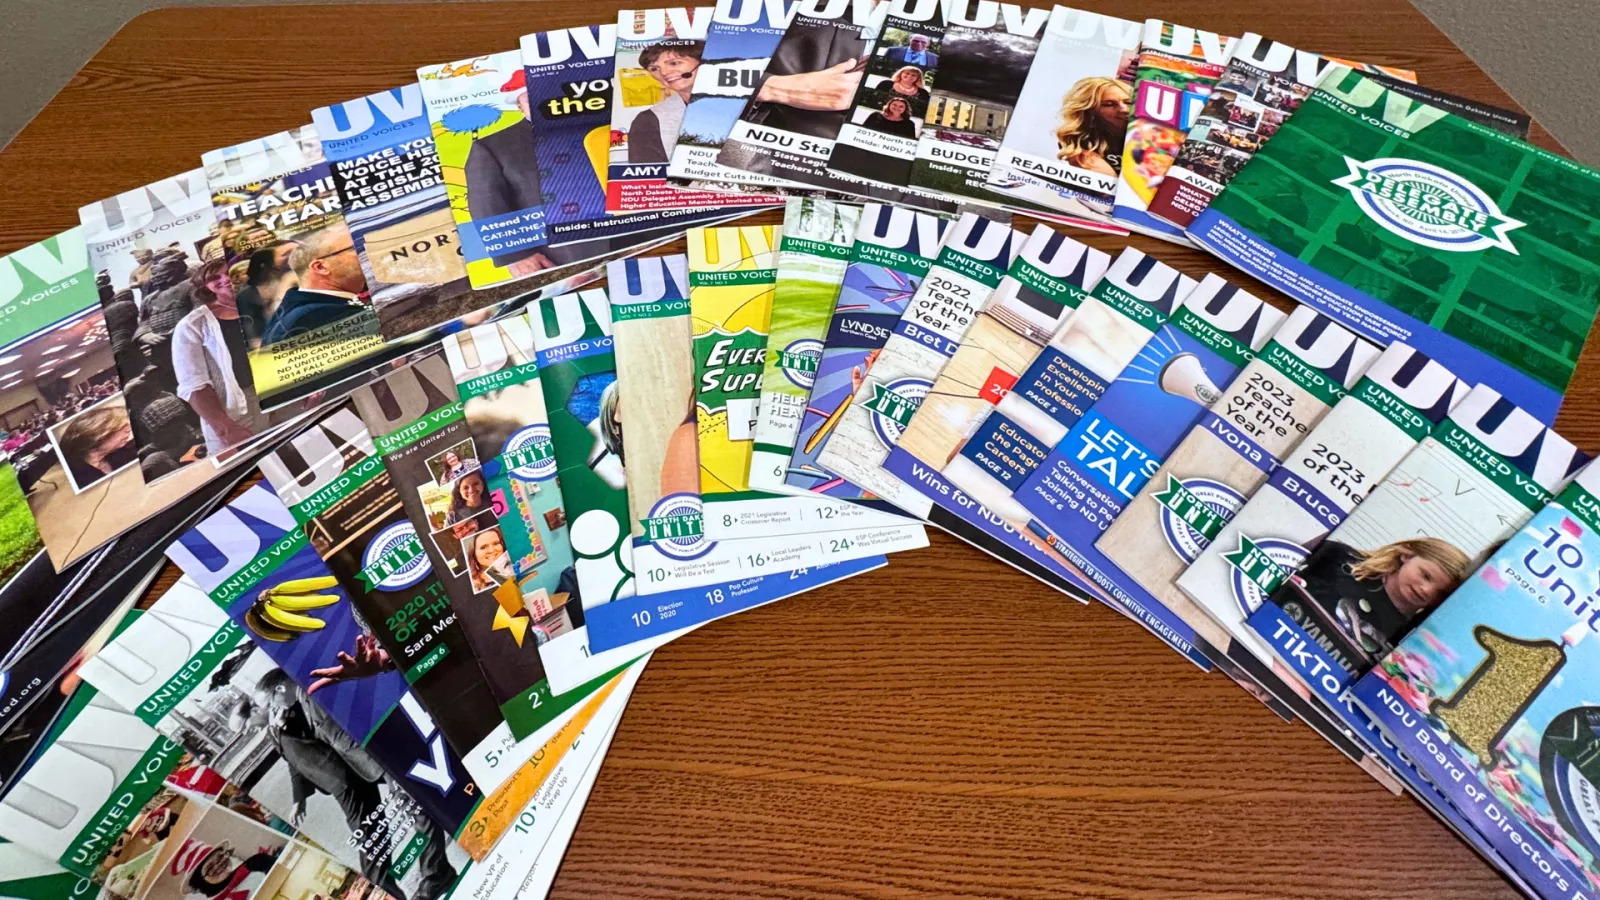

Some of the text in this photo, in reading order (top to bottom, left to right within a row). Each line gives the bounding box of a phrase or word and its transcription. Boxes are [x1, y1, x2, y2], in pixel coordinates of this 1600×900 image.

[618, 7, 715, 40] UV
[750, 27, 786, 35] VOICES
[1143, 18, 1241, 66] UV
[529, 59, 606, 74] UNITED VOICES
[311, 82, 424, 141] UV
[548, 97, 607, 116] the
[1314, 91, 1357, 115] UNITED
[1361, 113, 1410, 139] VOICES
[1443, 99, 1464, 109] North
[1465, 105, 1491, 117] Dakota
[1492, 113, 1517, 125] United
[329, 135, 368, 149] UNITED
[372, 121, 415, 136] VOICES
[746, 129, 794, 147] NDU
[853, 136, 903, 153] Inside: NDU
[856, 129, 877, 137] 2017
[879, 134, 903, 144] North
[344, 176, 369, 190] AT
[374, 162, 418, 181] THE
[622, 166, 662, 177] AMY
[684, 167, 721, 178] Budget
[724, 172, 747, 180] Cuts
[1007, 171, 1041, 186] Inside:
[1387, 172, 1412, 180] North
[1415, 173, 1449, 188] Dakota
[642, 195, 676, 203] Delegate
[679, 193, 714, 202] Assembly
[1361, 181, 1486, 232] ASSEMBLY
[1366, 171, 1489, 225] DELEGATE
[256, 196, 343, 232] YEAR
[554, 223, 591, 234] Inside:
[593, 213, 660, 228] Instructional
[96, 231, 145, 253] UNITED
[149, 213, 202, 234] VOICES
[485, 236, 540, 253] ND United
[1219, 220, 1277, 259] WHAT'S INSIDE:
[947, 252, 992, 276] UNITED
[931, 276, 970, 300] 2022
[1021, 264, 1066, 293] UNITED
[1207, 232, 1239, 257] EDUCATION
[1240, 255, 1267, 273] SUPPORT
[1268, 272, 1315, 300] PROFESSIONAL
[1328, 303, 1341, 313] THE
[1342, 311, 1361, 323] YEAR
[1361, 321, 1389, 338] NAMED
[919, 301, 968, 326] of the
[1106, 286, 1153, 317] UNITED
[271, 312, 374, 354] SPECIAL ISSUE:
[915, 309, 950, 331] Year
[287, 332, 367, 365] AND CANDIDATES
[904, 324, 943, 348] Bret
[784, 352, 809, 361] NORTH
[279, 371, 301, 382] 2014
[304, 362, 325, 373] FALL
[293, 369, 324, 384] TODAY
[1040, 372, 1078, 400] In Your
[1025, 389, 1057, 414] PAGE 5
[1250, 372, 1295, 407] 2023
[1233, 395, 1287, 437] of the
[1368, 385, 1423, 427] UNITED
[769, 420, 788, 429] Page
[1226, 404, 1265, 438] Year
[389, 453, 403, 463] We
[405, 445, 418, 458] are
[420, 431, 446, 448] United
[447, 424, 459, 435] for
[503, 446, 532, 459] NORTH
[1211, 418, 1262, 463] Ivona
[984, 441, 1026, 475] Careers
[1312, 443, 1366, 484] 2023
[1051, 468, 1099, 507] Talking to
[1303, 458, 1364, 505] of the
[1041, 476, 1097, 523] Joining ND
[1176, 488, 1217, 520] NORTH
[1282, 477, 1341, 527] Bruce
[829, 538, 850, 552] 24
[868, 529, 901, 540] Conference
[871, 537, 890, 546] Virtual
[891, 533, 913, 543] Success
[1543, 527, 1583, 569] 10
[674, 557, 730, 572] Legislative Session
[747, 553, 765, 568] 16
[647, 568, 665, 583] 10
[728, 576, 764, 591] Pop Culture
[1505, 567, 1547, 604] page 6
[658, 600, 683, 612] Election
[705, 588, 724, 606] 18
[1055, 541, 1193, 655] STRATEGIES TO BOOST COGNITIVE ENGAGEMENT
[385, 595, 427, 631] 2020
[632, 610, 651, 627] 10
[660, 610, 677, 620] 2020
[416, 646, 446, 674] Page 6
[528, 692, 543, 709] 2
[484, 751, 499, 768] 5
[545, 776, 568, 810] Wrap Up
[1376, 687, 1416, 729] NDU
[1416, 729, 1465, 783] Board
[1464, 783, 1486, 803] of
[1484, 803, 1570, 892] Directors
[72, 793, 134, 864] UNITED
[347, 792, 393, 848] 50 Years
[356, 798, 404, 854] Teachers
[515, 812, 535, 835] 10
[376, 815, 416, 867] strained by
[394, 837, 424, 874] Page 6
